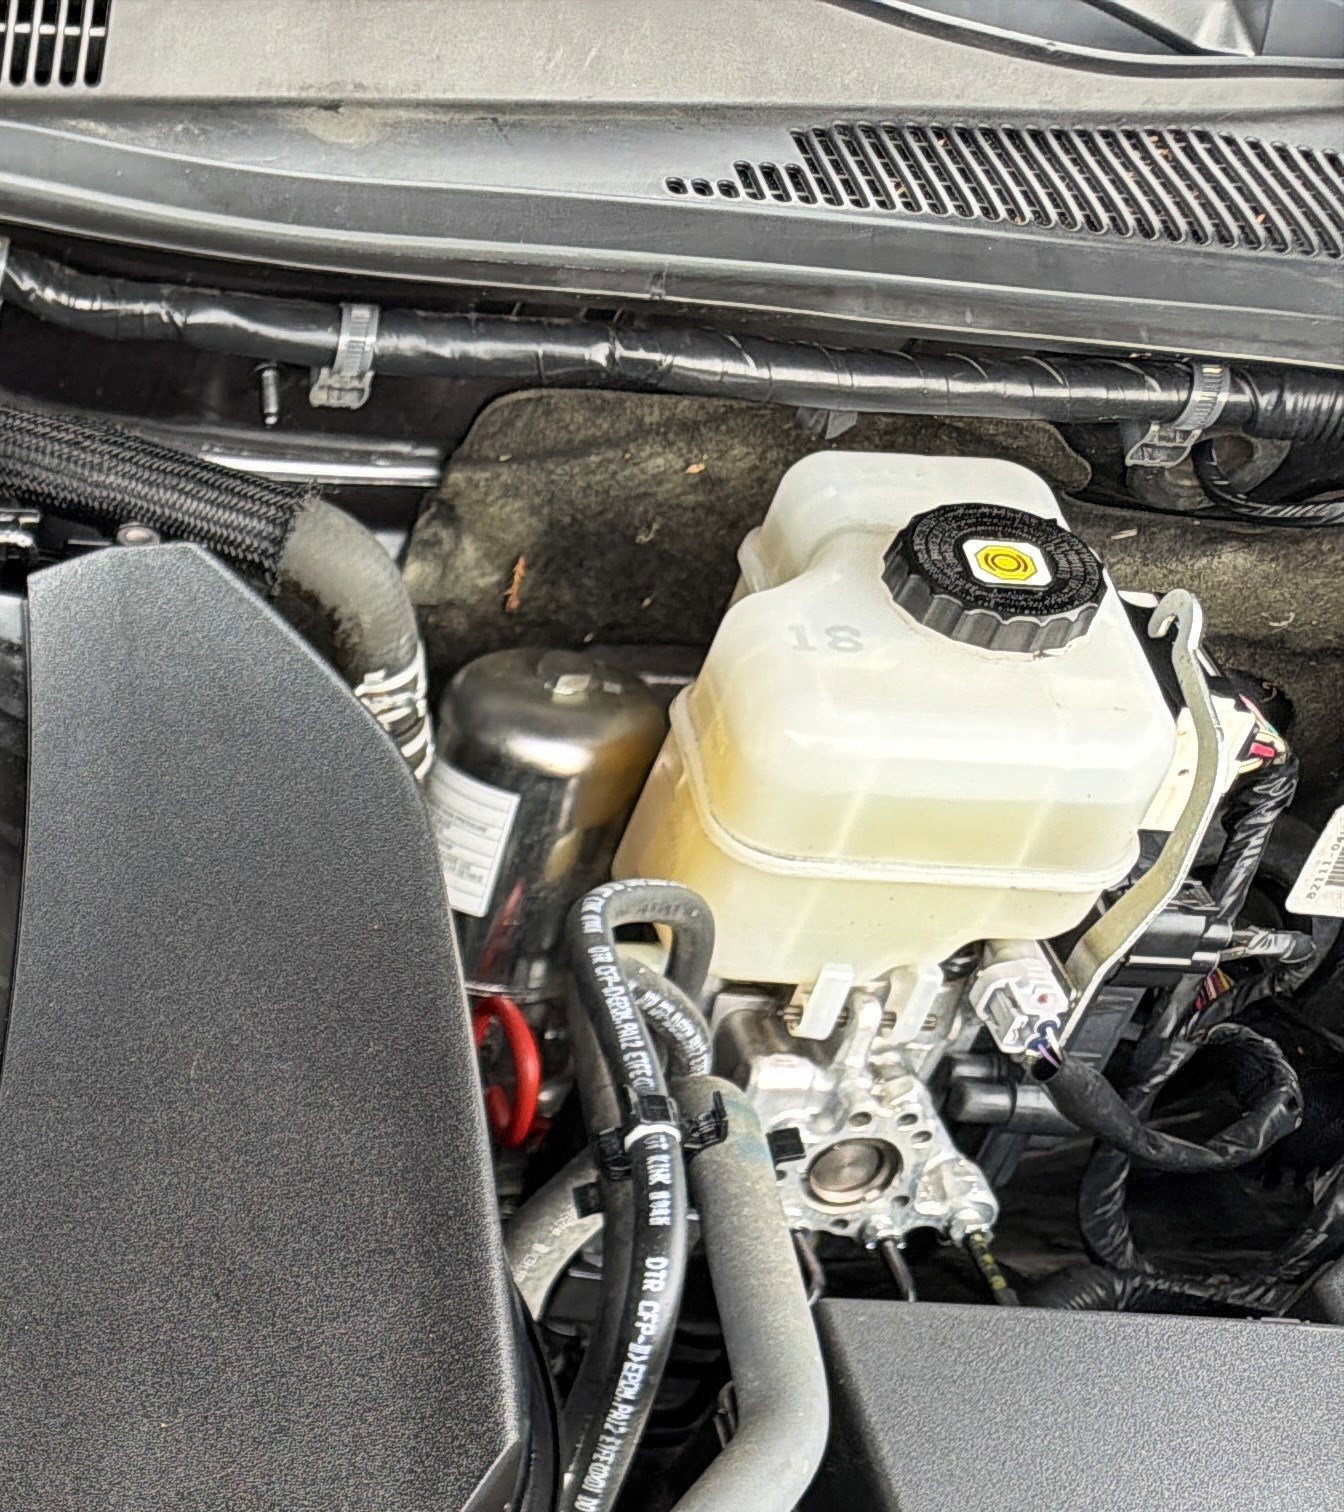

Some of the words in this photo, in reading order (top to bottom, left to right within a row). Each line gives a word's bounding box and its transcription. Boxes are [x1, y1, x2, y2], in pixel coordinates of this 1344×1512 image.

[787, 623, 864, 653] 18
[1306, 831, 1344, 900] 82111-04
[641, 1256, 669, 1292] DTR
